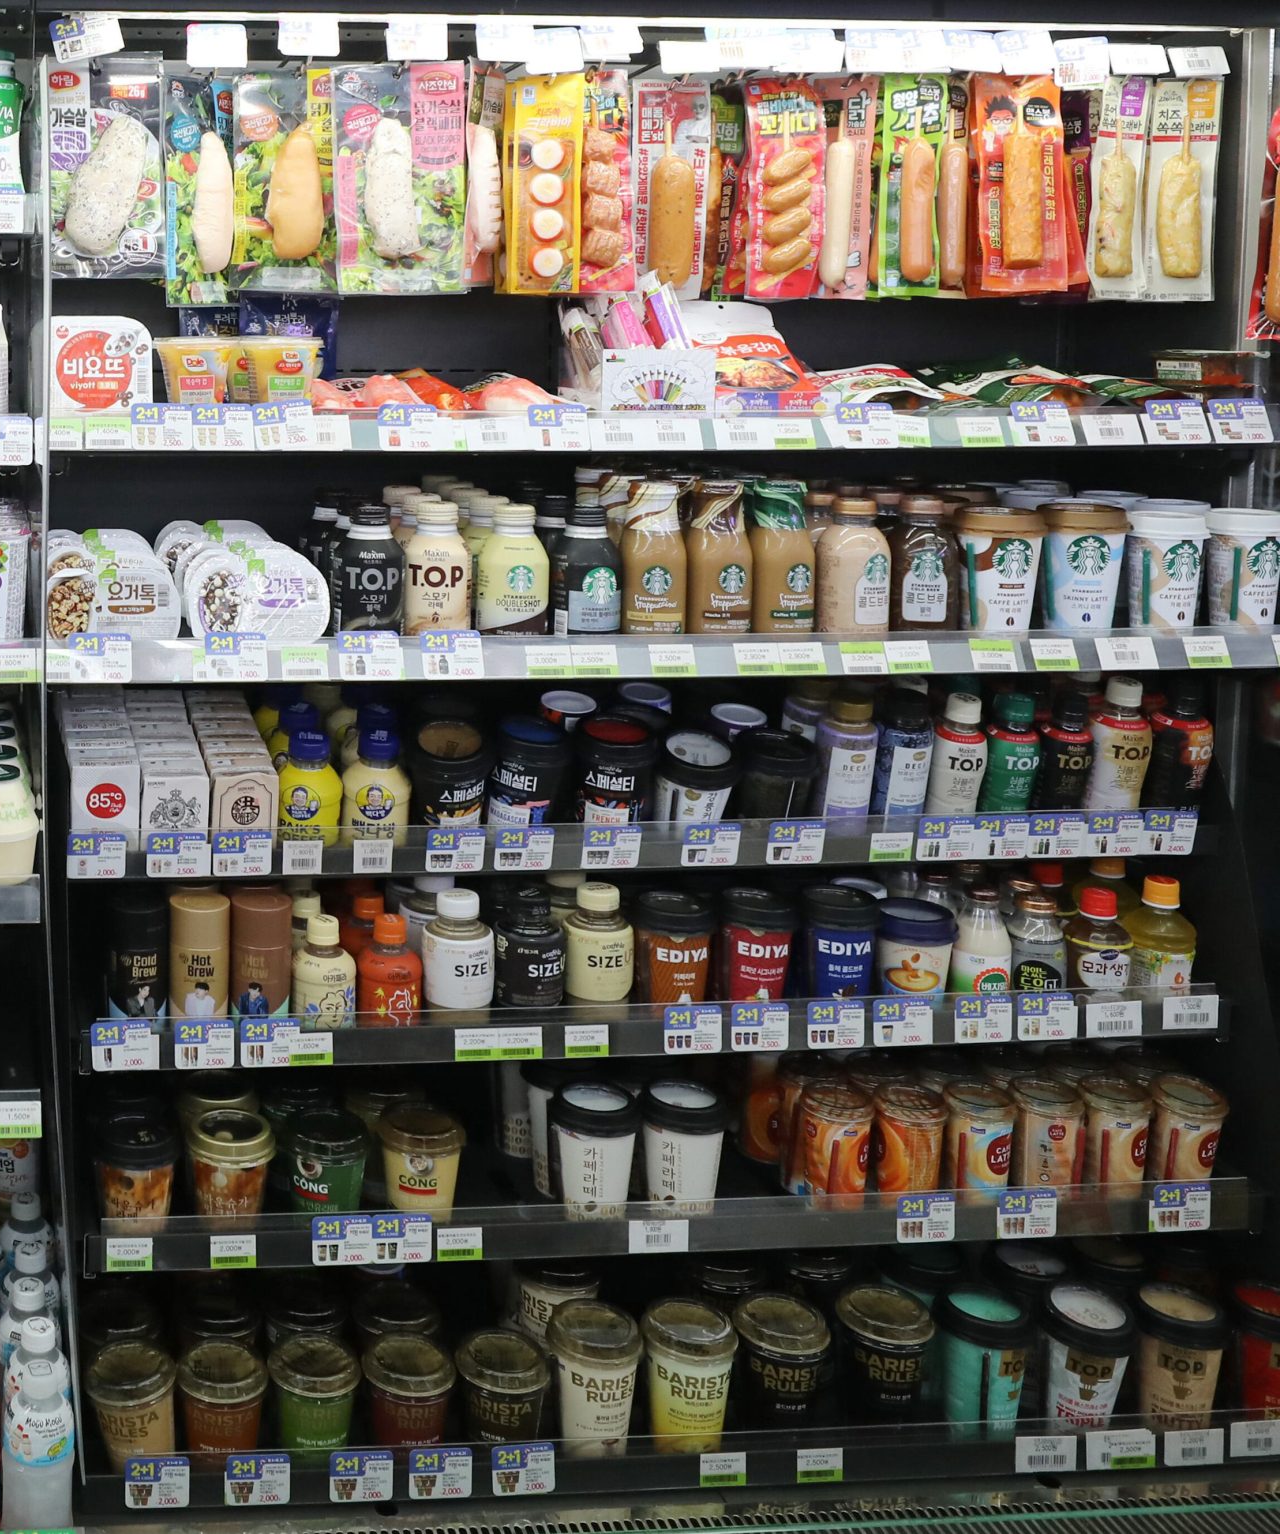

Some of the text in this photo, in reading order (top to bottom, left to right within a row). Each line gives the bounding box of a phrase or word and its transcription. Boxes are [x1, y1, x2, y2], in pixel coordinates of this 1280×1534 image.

[54, 22, 77, 35] 2+1
[51, 73, 74, 86] 하림
[1025, 107, 1052, 118] 맥스봉
[63, 357, 125, 379] 비요뜨
[185, 358, 204, 367] Dole
[197, 408, 218, 420] 2+1
[383, 409, 405, 421] 2+1
[1151, 403, 1173, 415] 2+1
[359, 551, 385, 560] Maxim
[346, 567, 400, 590] T.O.P
[409, 564, 463, 587] T.O.P
[108, 584, 156, 604] 요거톡
[361, 594, 387, 603] 스모키
[421, 592, 449, 601] 스모키
[75, 638, 98, 650] 2+1
[344, 636, 366, 648] 2+1
[1112, 745, 1149, 759] T.O.P
[948, 757, 983, 772] T.O.P
[1005, 755, 1039, 770] T.O.P
[1057, 755, 1091, 769] T.O.P
[585, 774, 634, 791] 스페셜티
[439, 781, 484, 803] 스페셜티
[1034, 818, 1056, 830] 2+1
[589, 831, 612, 843] 2+1
[773, 826, 795, 839] 2+1
[152, 837, 174, 849] 2+1
[432, 834, 455, 846] 2+1
[737, 940, 788, 958] EDIYA
[818, 938, 871, 956] EDIYA
[133, 954, 157, 967] Cold
[191, 954, 211, 967] Hot
[657, 948, 708, 963] EDIYA
[132, 966, 157, 977] Brew
[187, 965, 215, 977] Brew
[736, 1008, 758, 1020] 2+1
[879, 1004, 900, 1016] 2+1
[97, 1028, 119, 1041] 2+1
[246, 1025, 268, 1037] 2+1
[583, 1147, 598, 1198] 카페라떼
[662, 1141, 676, 1192] 카페라떼
[1005, 1195, 1026, 1209] 2+1
[377, 1220, 399, 1233] 2+1
[670, 1385, 724, 1401] RULES
[498, 1450, 521, 1464] 2+1
[130, 1463, 154, 1477] 2+1
[335, 1458, 359, 1472] 2+1
